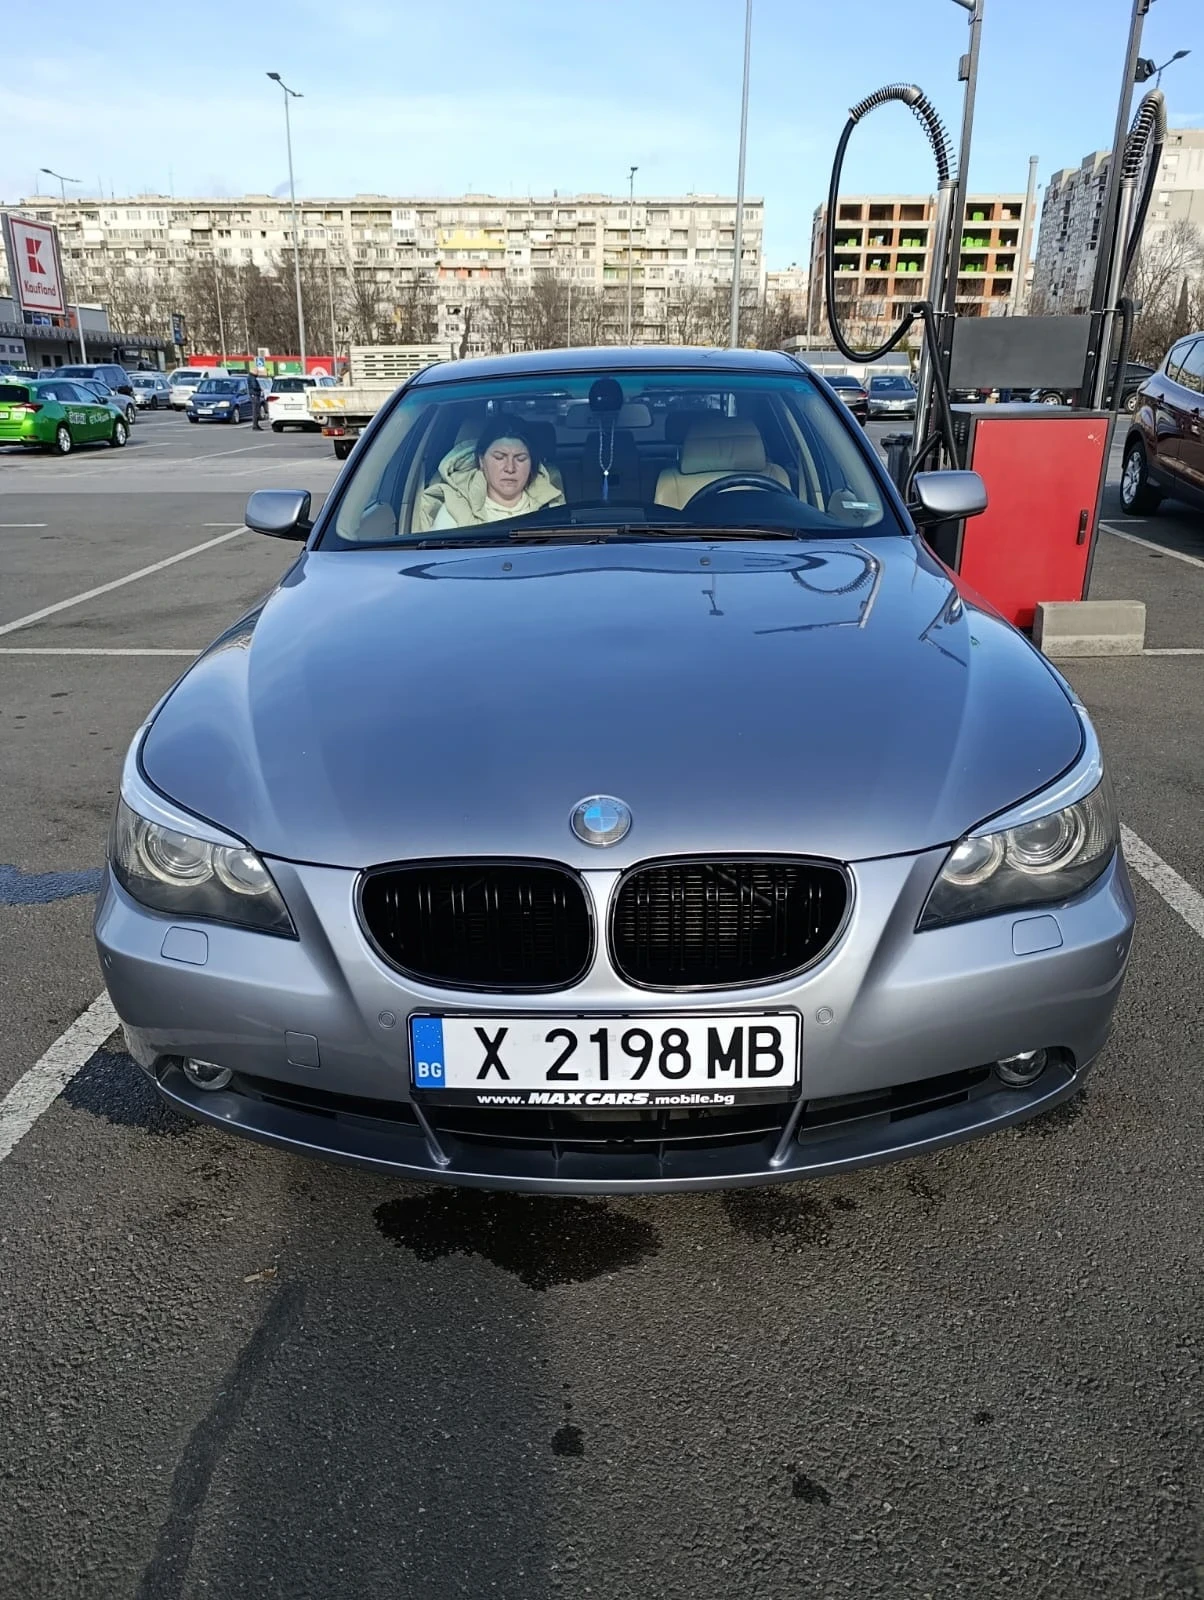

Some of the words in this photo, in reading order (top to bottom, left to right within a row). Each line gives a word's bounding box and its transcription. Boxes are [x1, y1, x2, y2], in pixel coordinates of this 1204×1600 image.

[25, 237, 46, 275] K
[24, 280, 56, 296] Kaufland
[473, 1026, 511, 1081] X
[544, 1027, 692, 1081] 2198
[706, 1025, 784, 1079] MB
[417, 1062, 442, 1079] BG
